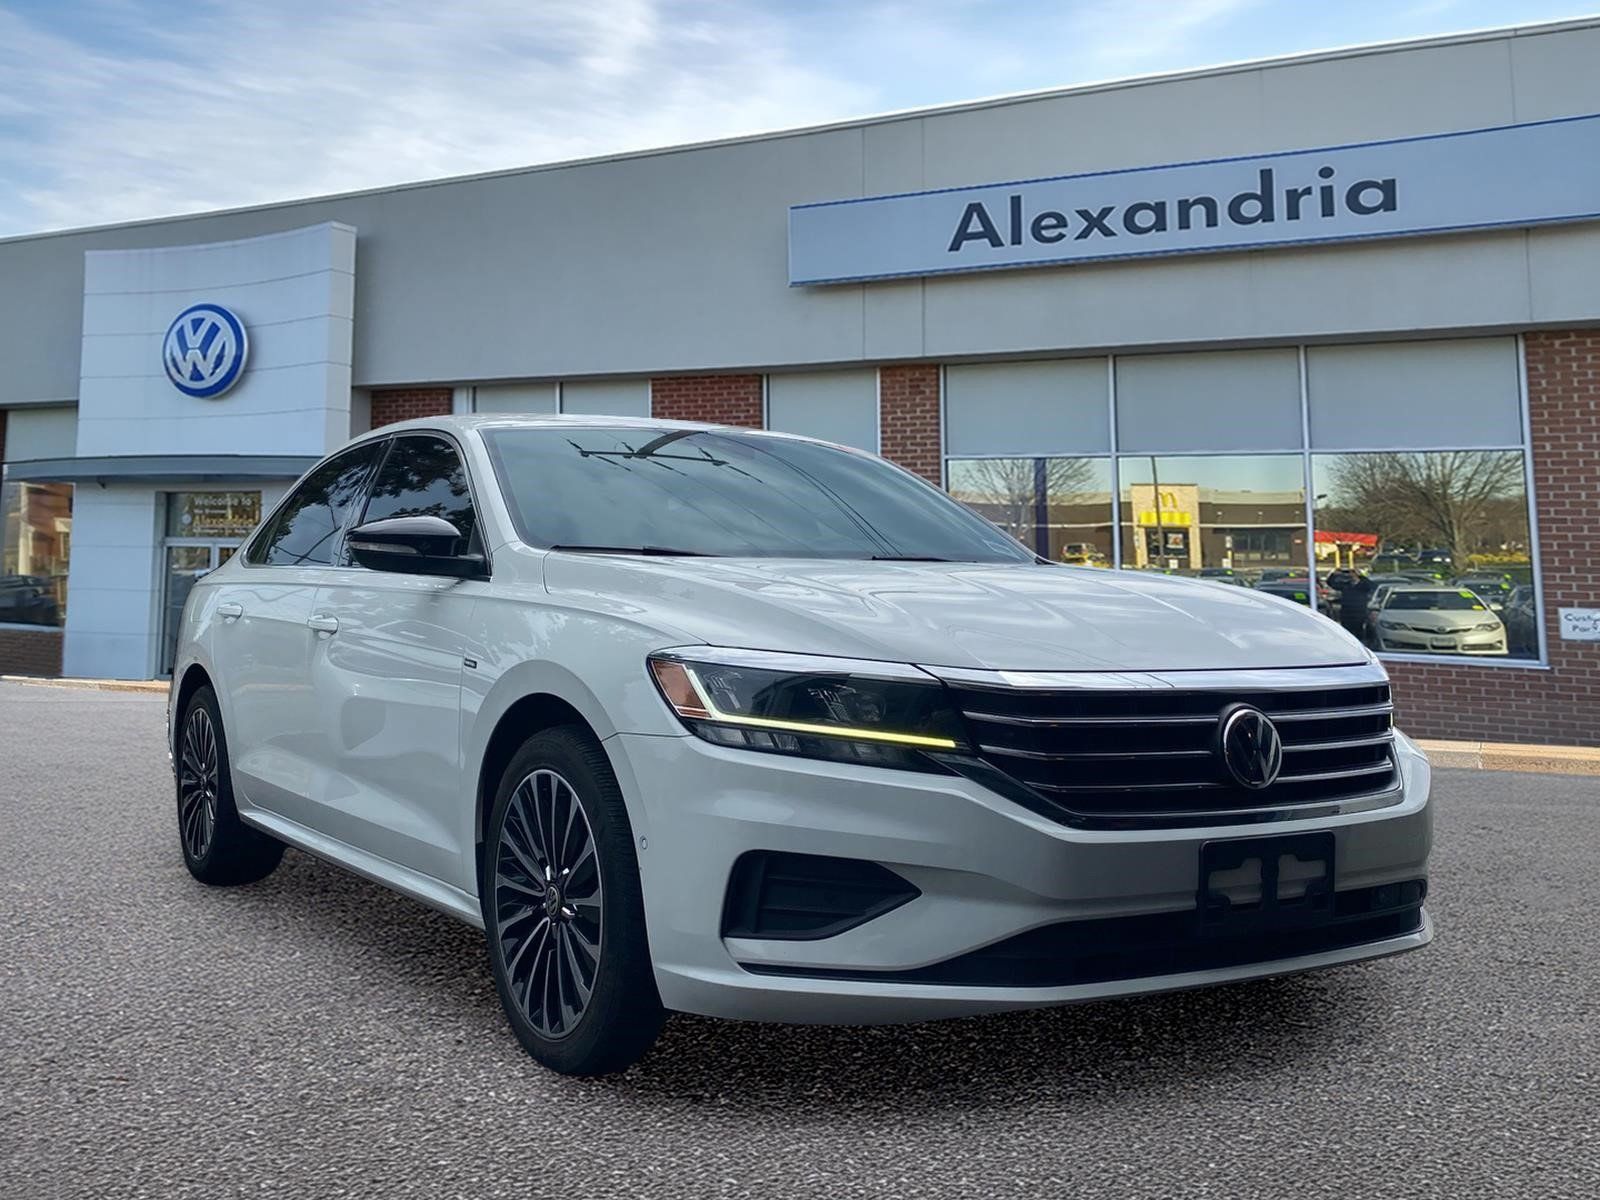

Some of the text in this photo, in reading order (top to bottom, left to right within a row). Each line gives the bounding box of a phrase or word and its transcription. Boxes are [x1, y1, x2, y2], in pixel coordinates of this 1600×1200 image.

[947, 166, 1398, 252] Alexandria
[165, 308, 239, 391] VW
[193, 496, 238, 506] Welcome
